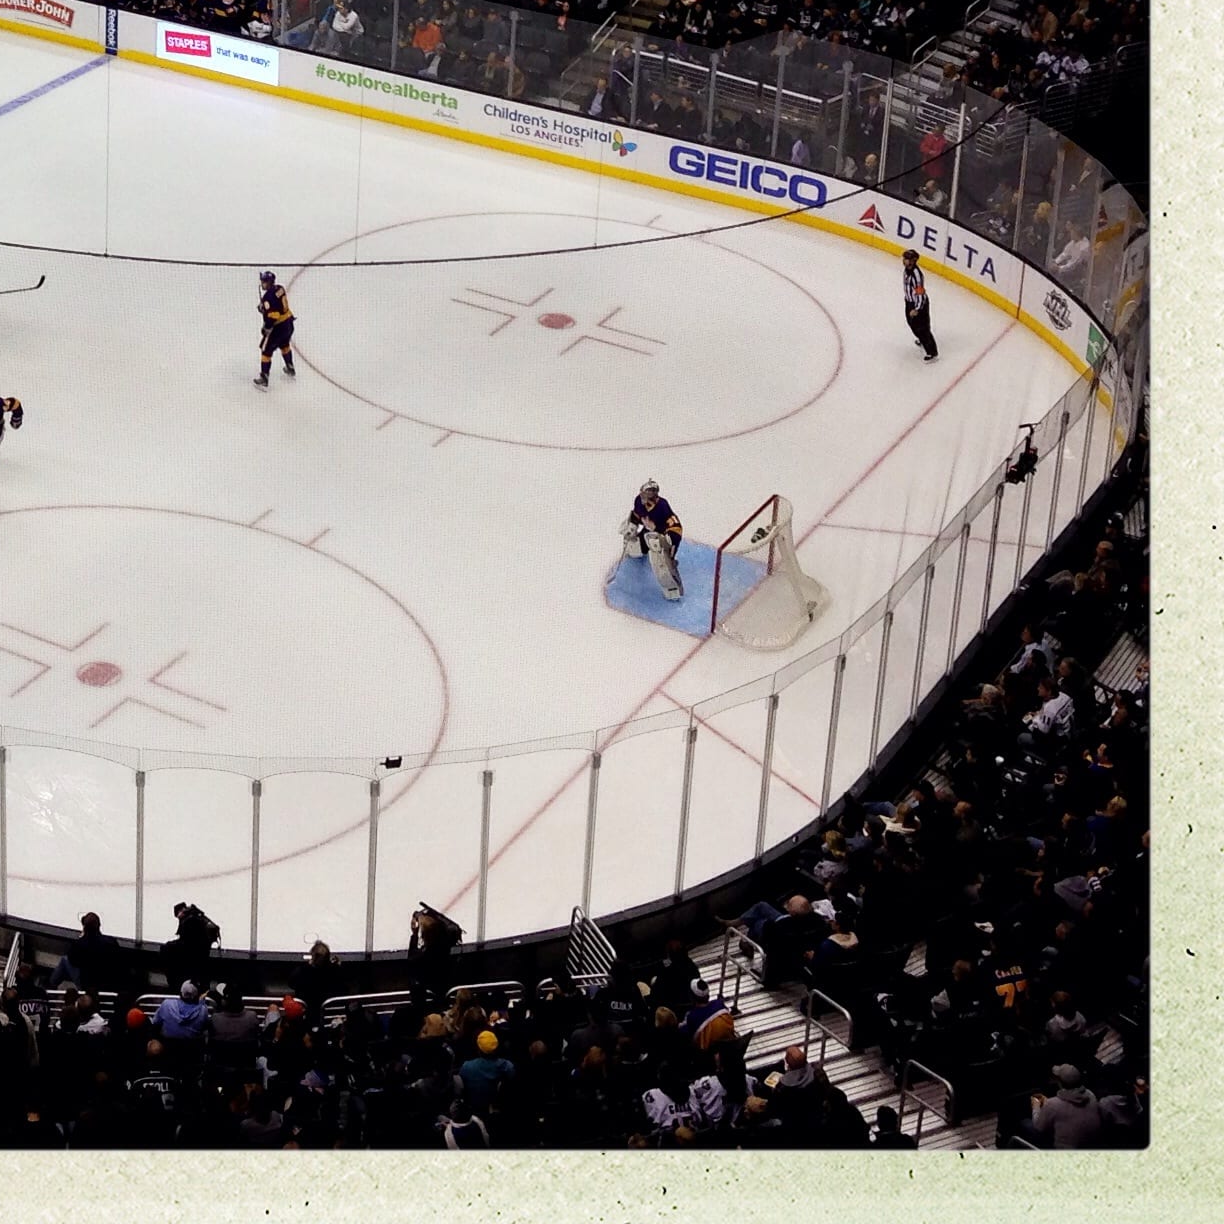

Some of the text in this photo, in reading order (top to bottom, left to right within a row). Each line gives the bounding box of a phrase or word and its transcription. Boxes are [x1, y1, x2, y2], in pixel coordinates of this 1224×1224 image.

[107, 8, 116, 48] Reebok
[167, 36, 208, 51] STAPLES
[216, 46, 248, 62] that was
[314, 63, 459, 111] #explorealberta
[483, 103, 548, 129] Children's
[553, 119, 612, 144] Hospital
[510, 124, 580, 147] LOS ANGELES
[669, 144, 828, 209] GEICO
[896, 215, 997, 284] DELTA
